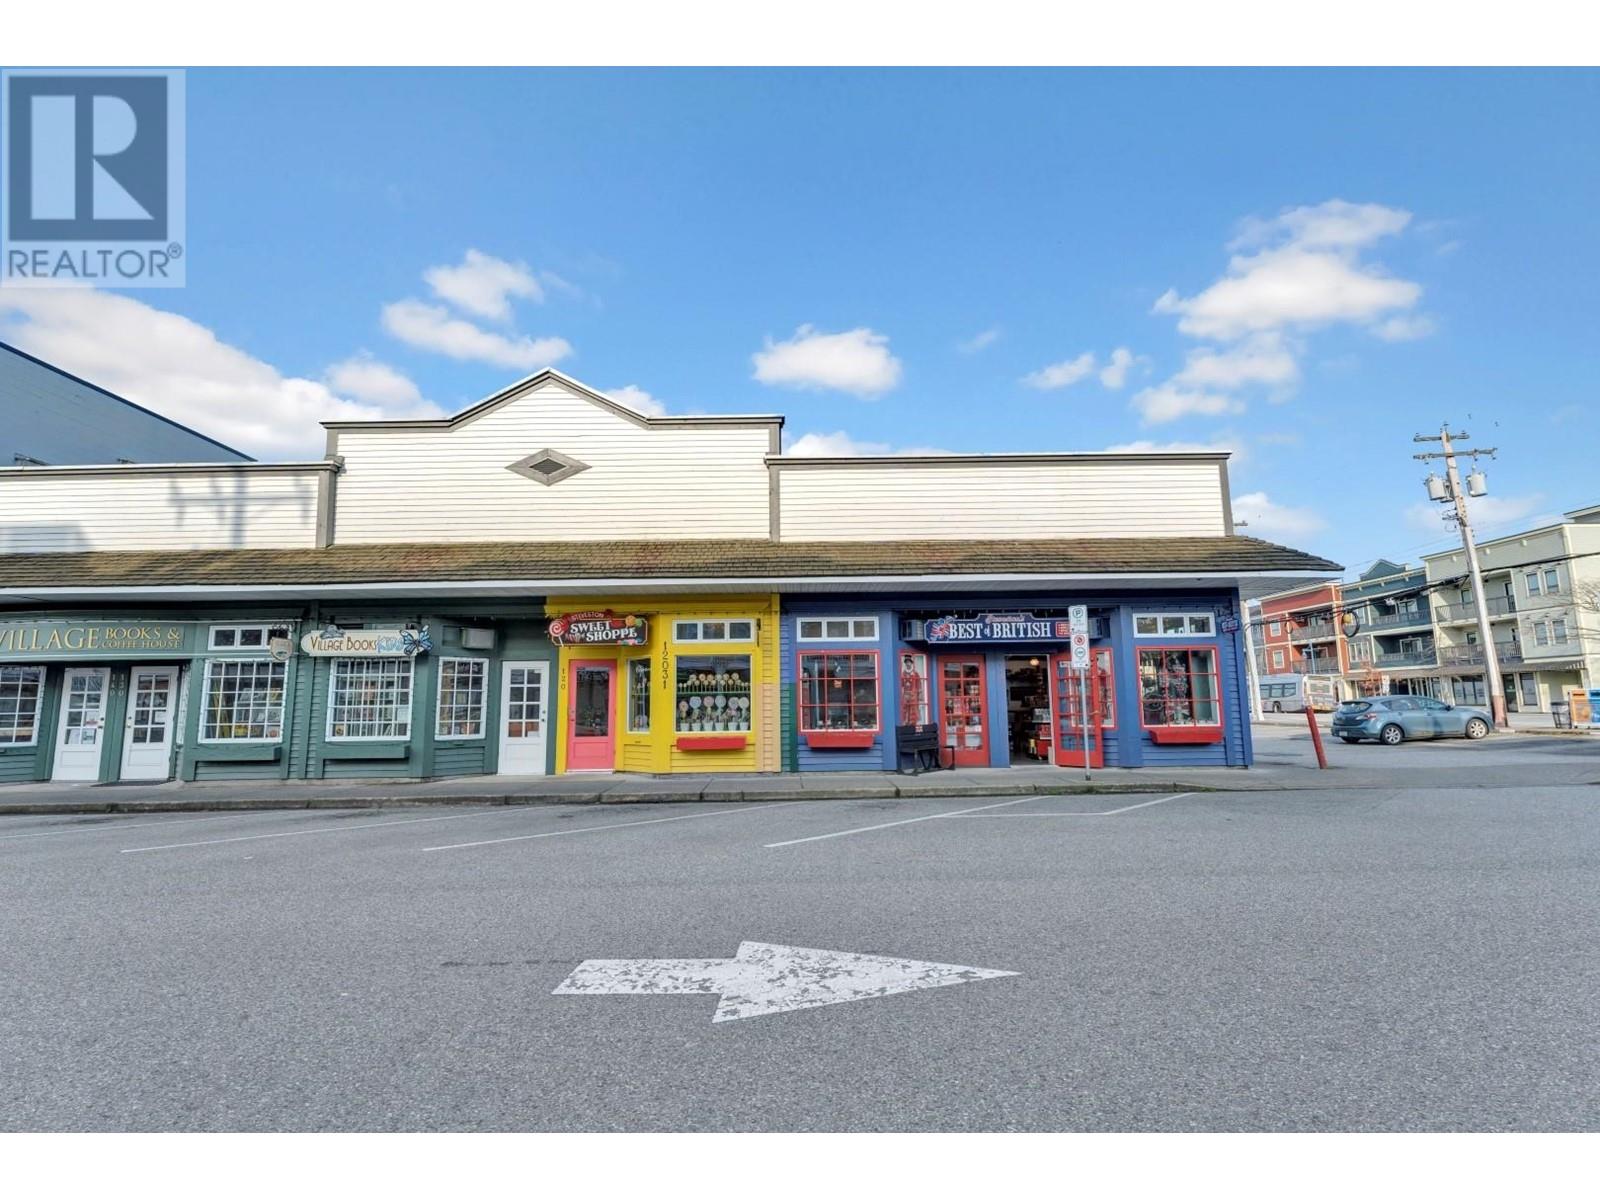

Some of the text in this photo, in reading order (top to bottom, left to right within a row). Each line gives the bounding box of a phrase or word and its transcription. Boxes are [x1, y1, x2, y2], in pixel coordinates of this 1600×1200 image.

[105, 627, 161, 640] BOOKS
[167, 627, 180, 639] &
[570, 620, 611, 634] SWEET
[949, 622, 983, 639] BEST
[992, 622, 1051, 638] BRITISH
[586, 627, 638, 642] SHOPPE
